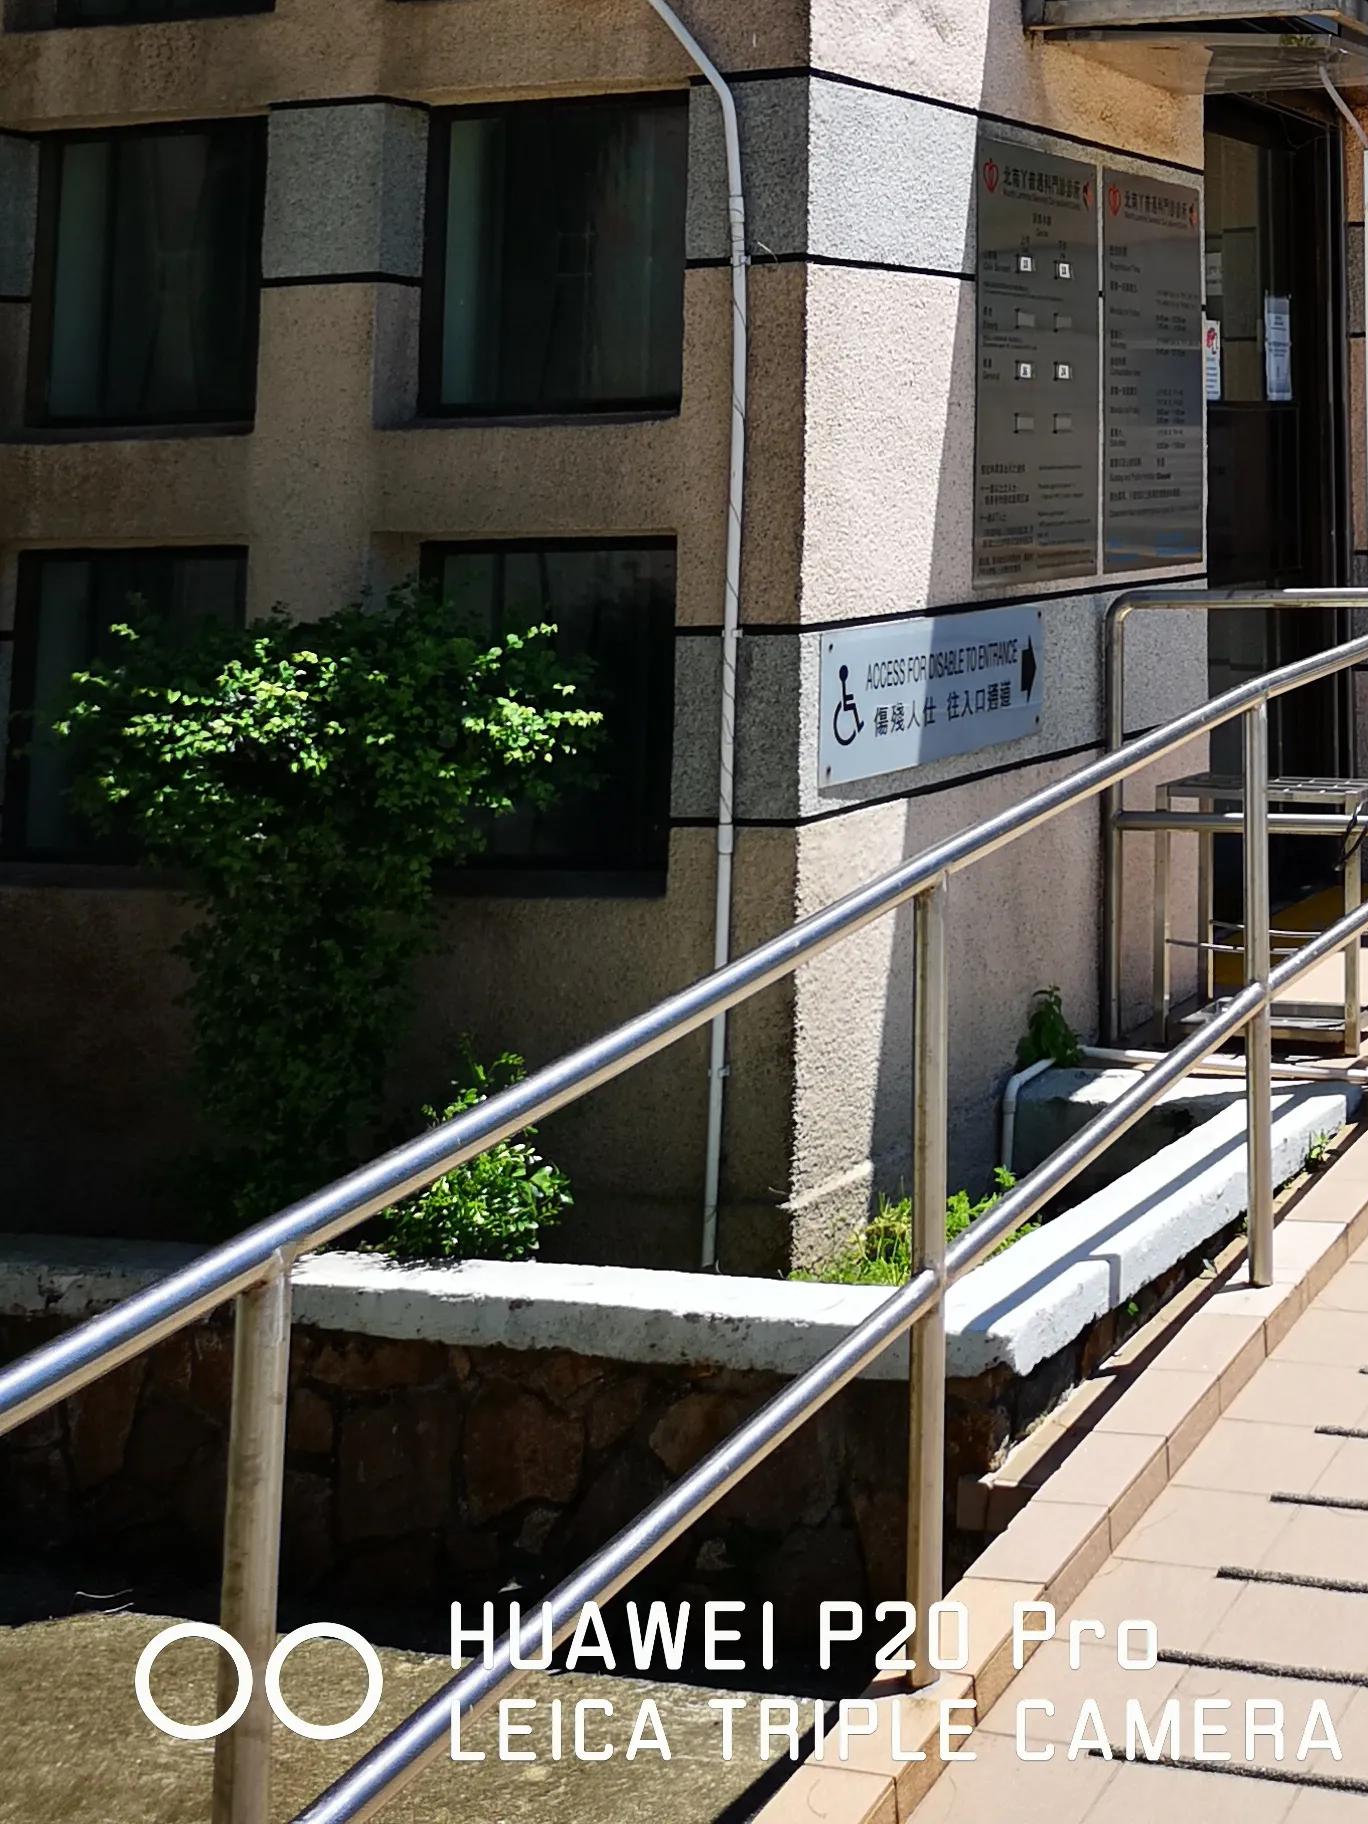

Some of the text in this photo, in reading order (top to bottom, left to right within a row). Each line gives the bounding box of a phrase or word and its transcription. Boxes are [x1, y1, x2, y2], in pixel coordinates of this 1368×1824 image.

[866, 637, 1019, 691] ACCESS FOR DISABLE TO ENTRANCE
[874, 694, 937, 738] 傷殘人仕
